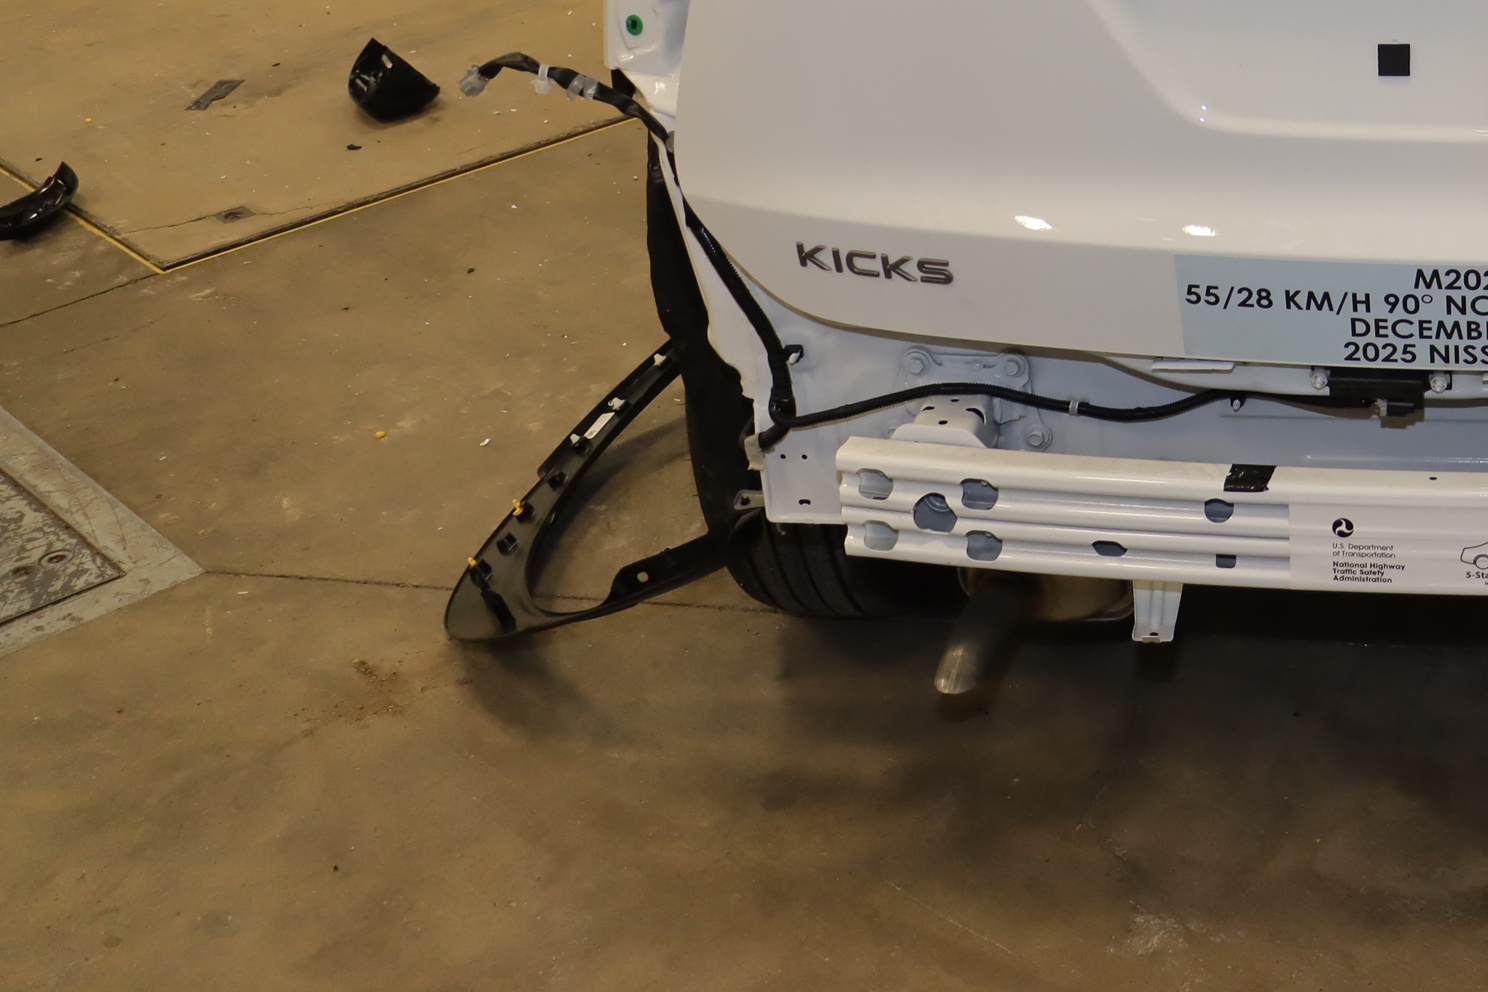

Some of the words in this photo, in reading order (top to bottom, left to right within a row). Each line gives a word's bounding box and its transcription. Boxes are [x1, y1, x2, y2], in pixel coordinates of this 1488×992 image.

[795, 241, 954, 285] KICKS
[1185, 284, 1274, 310] 55/28
[1284, 289, 1372, 316] KM/H
[1383, 293, 1434, 315] 90°
[1343, 341, 1417, 363] 2025
[1332, 542, 1347, 550] U.S.
[1348, 543, 1394, 551] Department
[1342, 550, 1396, 558] Transportation
[1369, 562, 1406, 571] Highway
[1359, 569, 1385, 577] Safety
[1332, 575, 1393, 583] Administration
